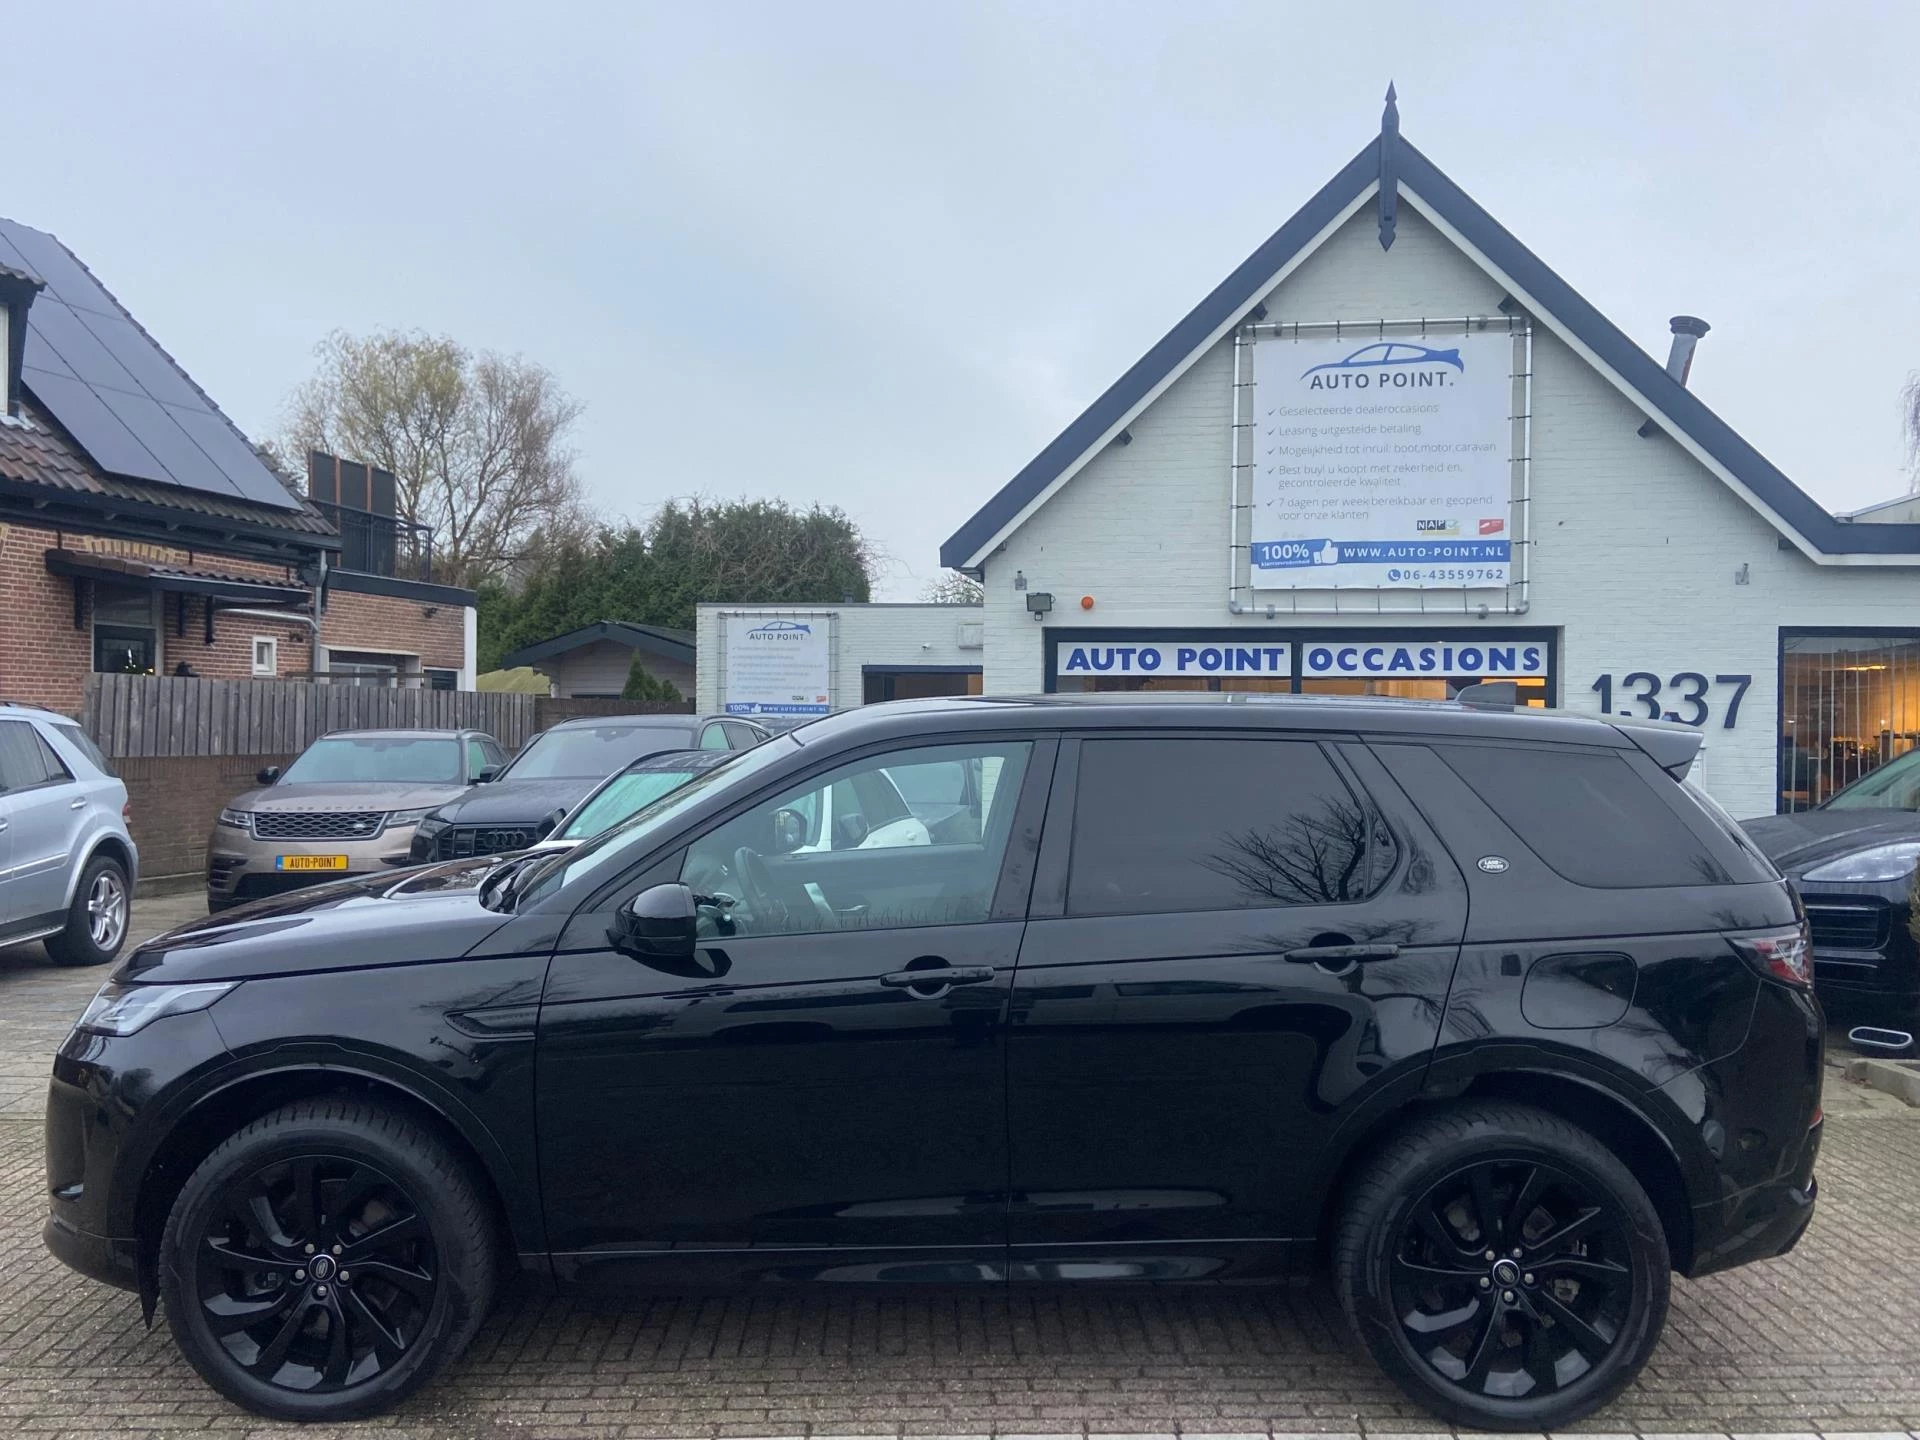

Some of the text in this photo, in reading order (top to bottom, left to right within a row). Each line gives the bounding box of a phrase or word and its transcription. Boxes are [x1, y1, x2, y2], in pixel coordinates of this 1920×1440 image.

[1310, 371, 1454, 390] AUTO POINT.
[1279, 403, 1439, 417] Geselecteerde dealeroccasions
[1380, 423, 1422, 435] betaling
[1279, 444, 1343, 457] Mogelijkheid
[1345, 445, 1360, 454] tot
[1279, 465, 1300, 475] Best
[1328, 466, 1335, 474] u
[1338, 464, 1367, 476] koopt
[1370, 464, 1390, 473] met
[1393, 462, 1444, 473] zekerheid
[1278, 476, 1401, 490] gecontroleerde kwaliteit
[1279, 495, 1493, 509] 7 dagen per week bereikbaar en geopend
[1278, 510, 1369, 520] voor onze klanten
[1262, 543, 1309, 560] 100%
[1344, 546, 1504, 558] WWW.AUTO-POINT.NL
[1403, 569, 1504, 580] 06-43559762
[749, 633, 774, 641] AUTO
[1065, 647, 1285, 671] AUTO POINT
[1308, 647, 1543, 671] OCCASIONS
[1591, 671, 1752, 729] 1337
[730, 704, 750, 712] 100%
[289, 857, 337, 868] AUTO-POINT
